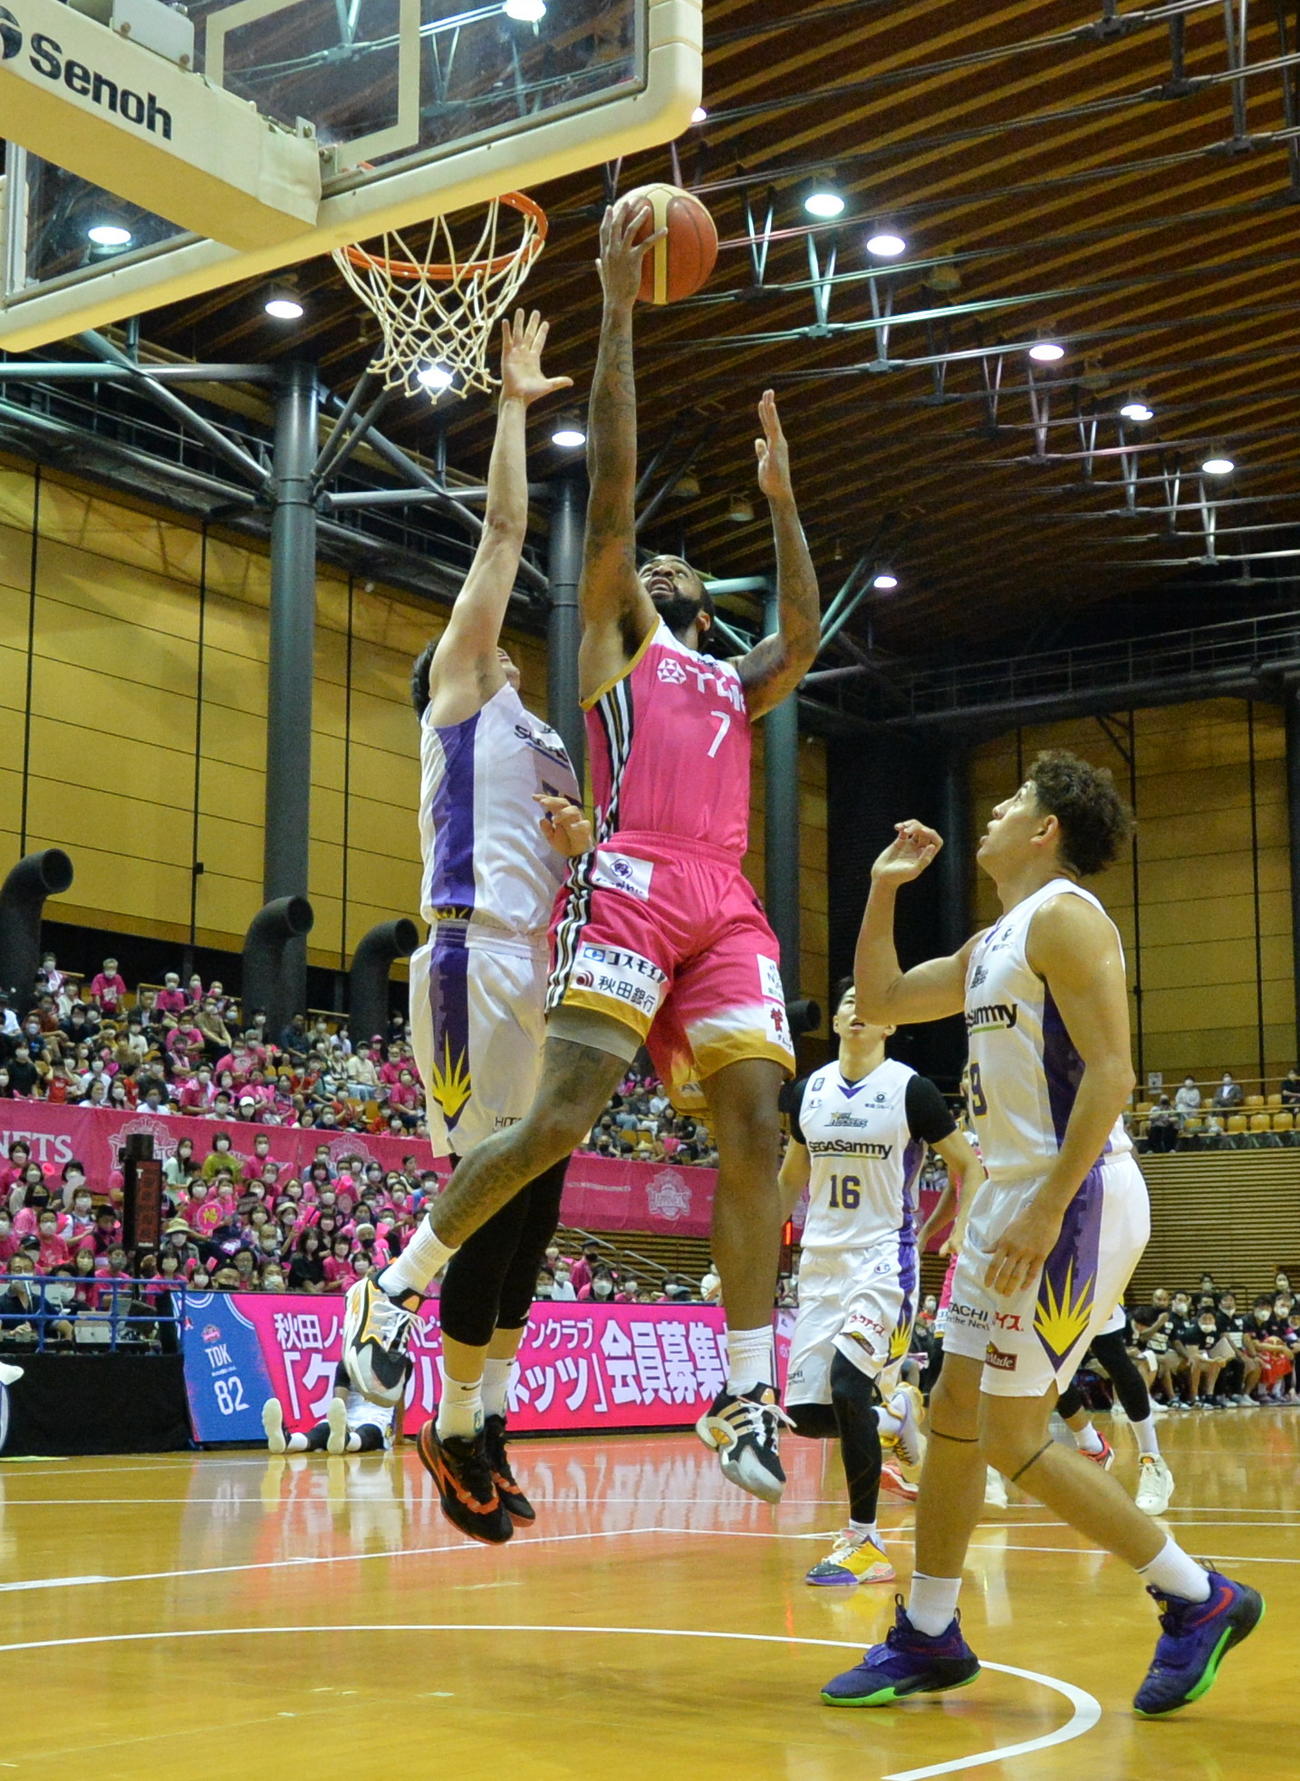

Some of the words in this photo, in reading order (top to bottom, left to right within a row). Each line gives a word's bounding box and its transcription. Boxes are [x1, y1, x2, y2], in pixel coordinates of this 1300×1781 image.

[30, 33, 172, 140] Senoh
[707, 711, 731, 758] 7
[598, 976, 656, 1013] 秋田銀行
[495, 1116, 522, 1128] HIT
[829, 1174, 861, 1209] 16
[204, 1343, 233, 1369] TDK
[214, 1375, 250, 1416] 82
